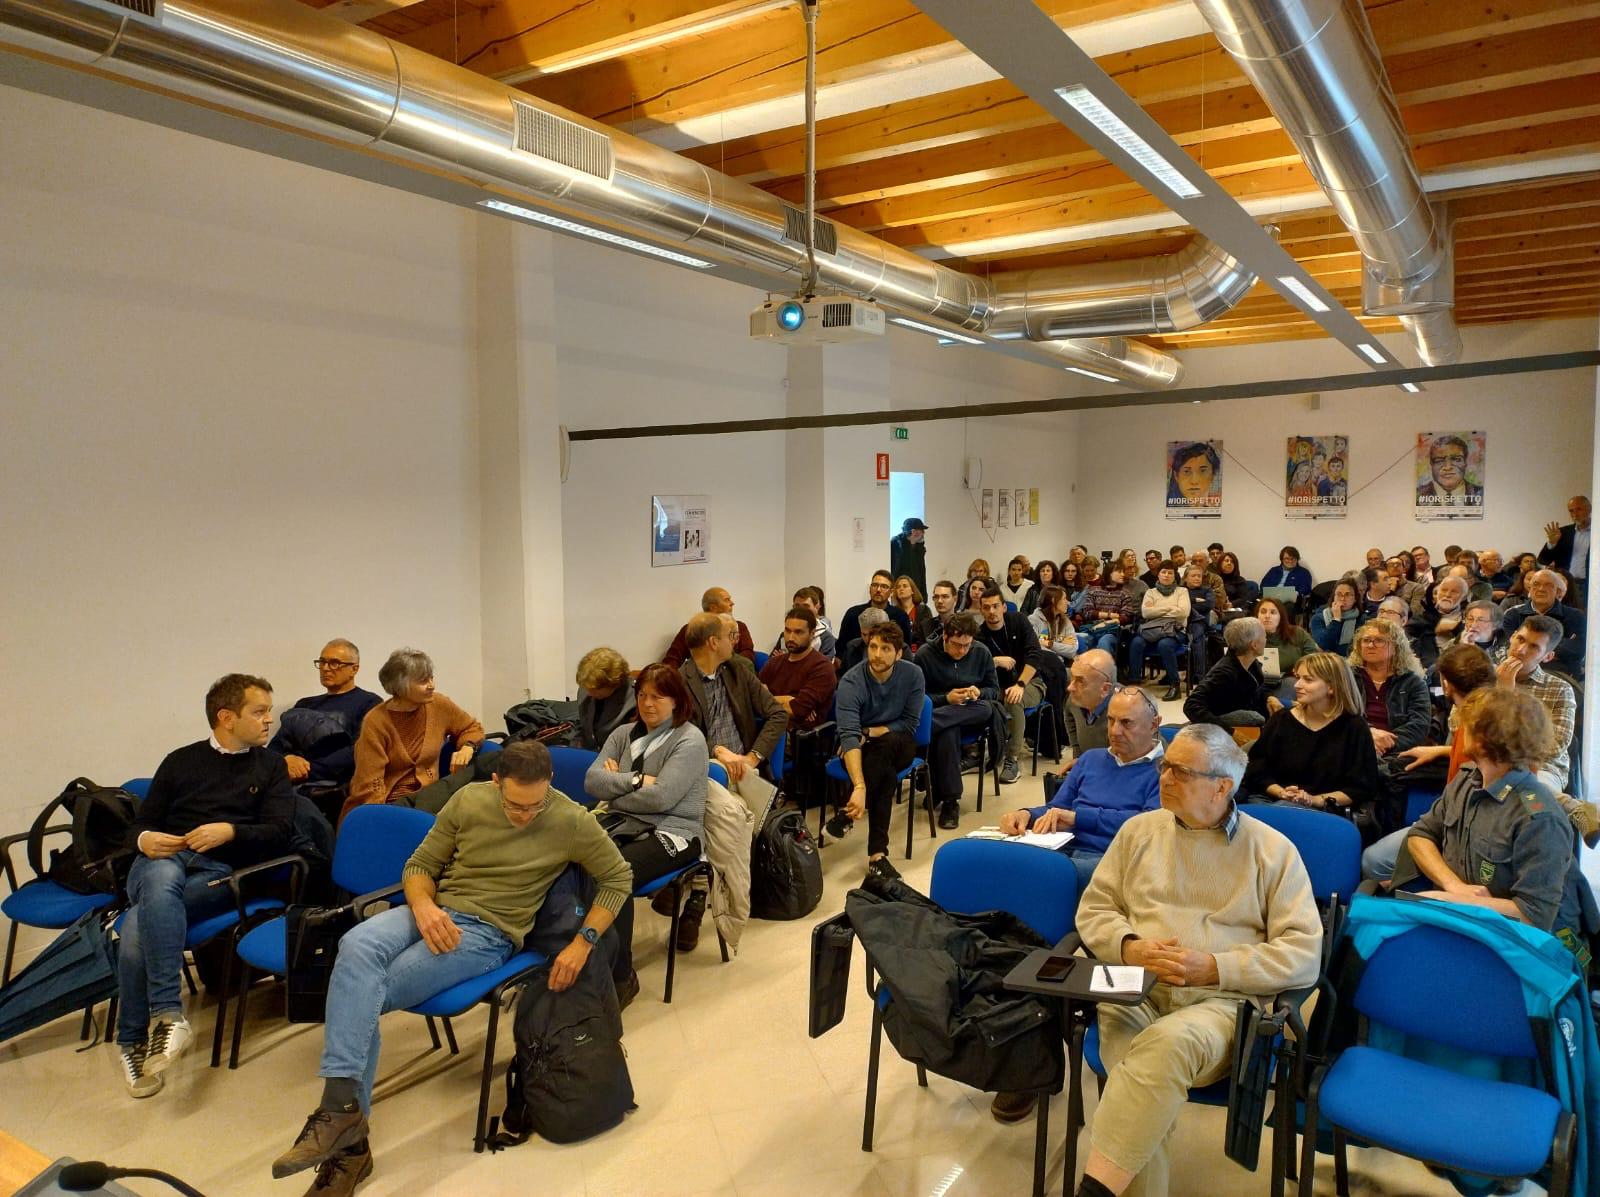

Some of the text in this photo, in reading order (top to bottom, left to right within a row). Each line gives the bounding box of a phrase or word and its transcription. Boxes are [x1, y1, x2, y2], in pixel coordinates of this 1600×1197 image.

[1168, 496, 1220, 504] #IORISPETTO
[1288, 495, 1345, 503] #IORISPETTO
[1419, 495, 1481, 503] #IORISPETTO
